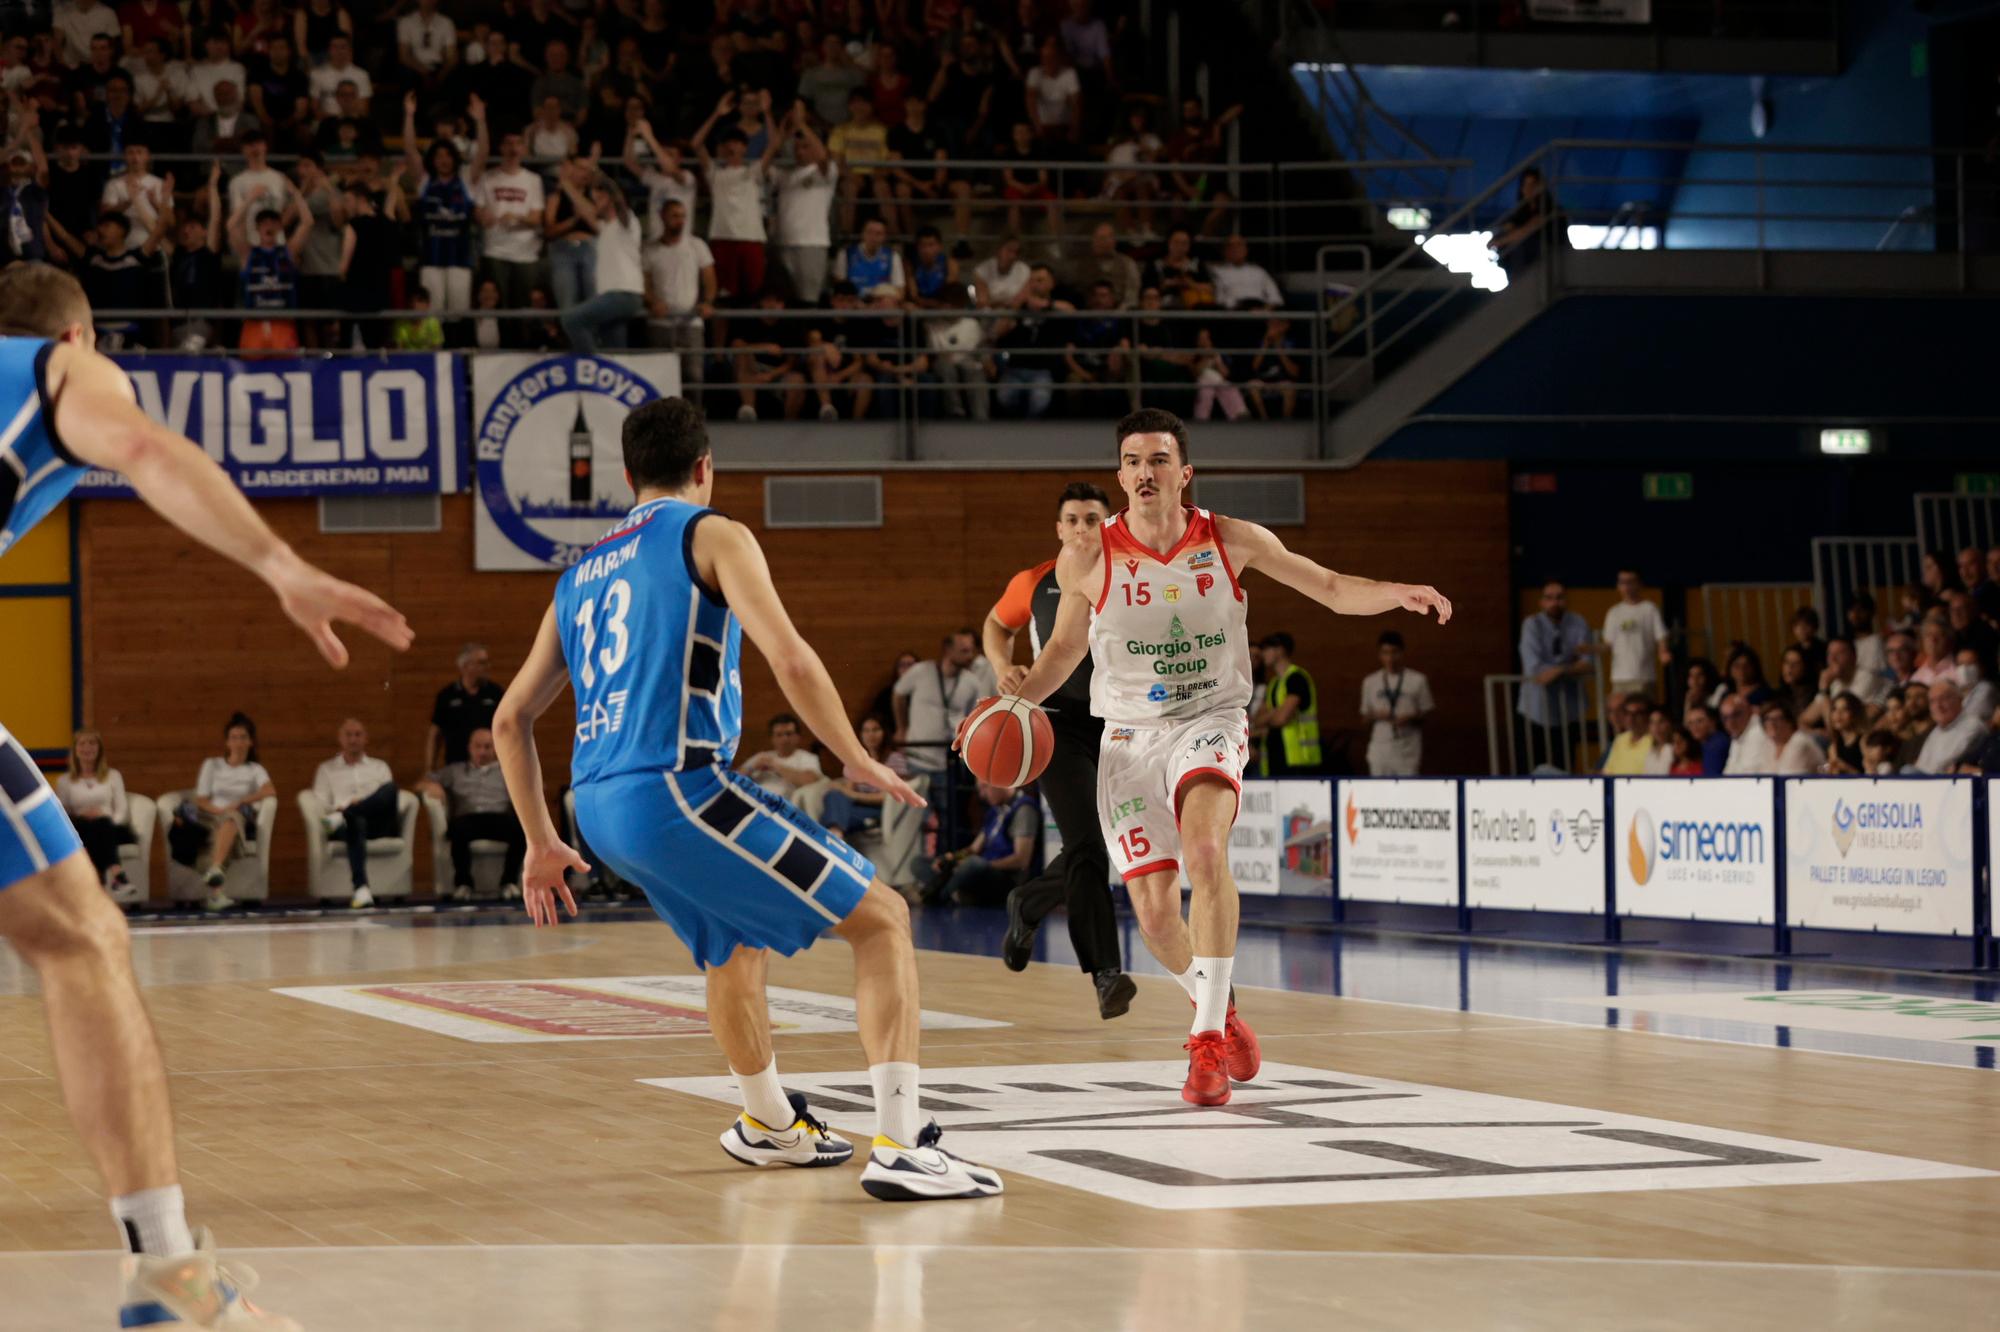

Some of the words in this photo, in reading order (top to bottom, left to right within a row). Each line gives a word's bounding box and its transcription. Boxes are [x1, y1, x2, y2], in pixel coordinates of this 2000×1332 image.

[126, 369, 429, 464] VIGLIO
[477, 364, 568, 461] Rangers
[574, 358, 648, 405] Boys
[241, 466, 380, 488] LASCEREMO
[384, 465, 430, 484] MAI
[550, 543, 584, 567] 20
[1121, 582, 1152, 607] 15
[575, 578, 632, 690] 13
[1126, 638, 1192, 659] Giorgio
[1194, 628, 1227, 650] Tesi
[1152, 657, 1207, 676] Group
[1176, 678, 1219, 694] FLORENCE
[1471, 808, 1537, 842] Rivoltella
[1857, 802, 1924, 829] GRISOLIA
[1118, 826, 1151, 863] 15
[1659, 820, 1764, 864] simecom
[1857, 831, 1924, 850] IMBALLAGGI
[1809, 864, 1839, 883] PALLET
[1847, 866, 1902, 886] IMBALLAGGI
[1903, 868, 1914, 887] IN
[1916, 868, 1947, 888] LEGNO
